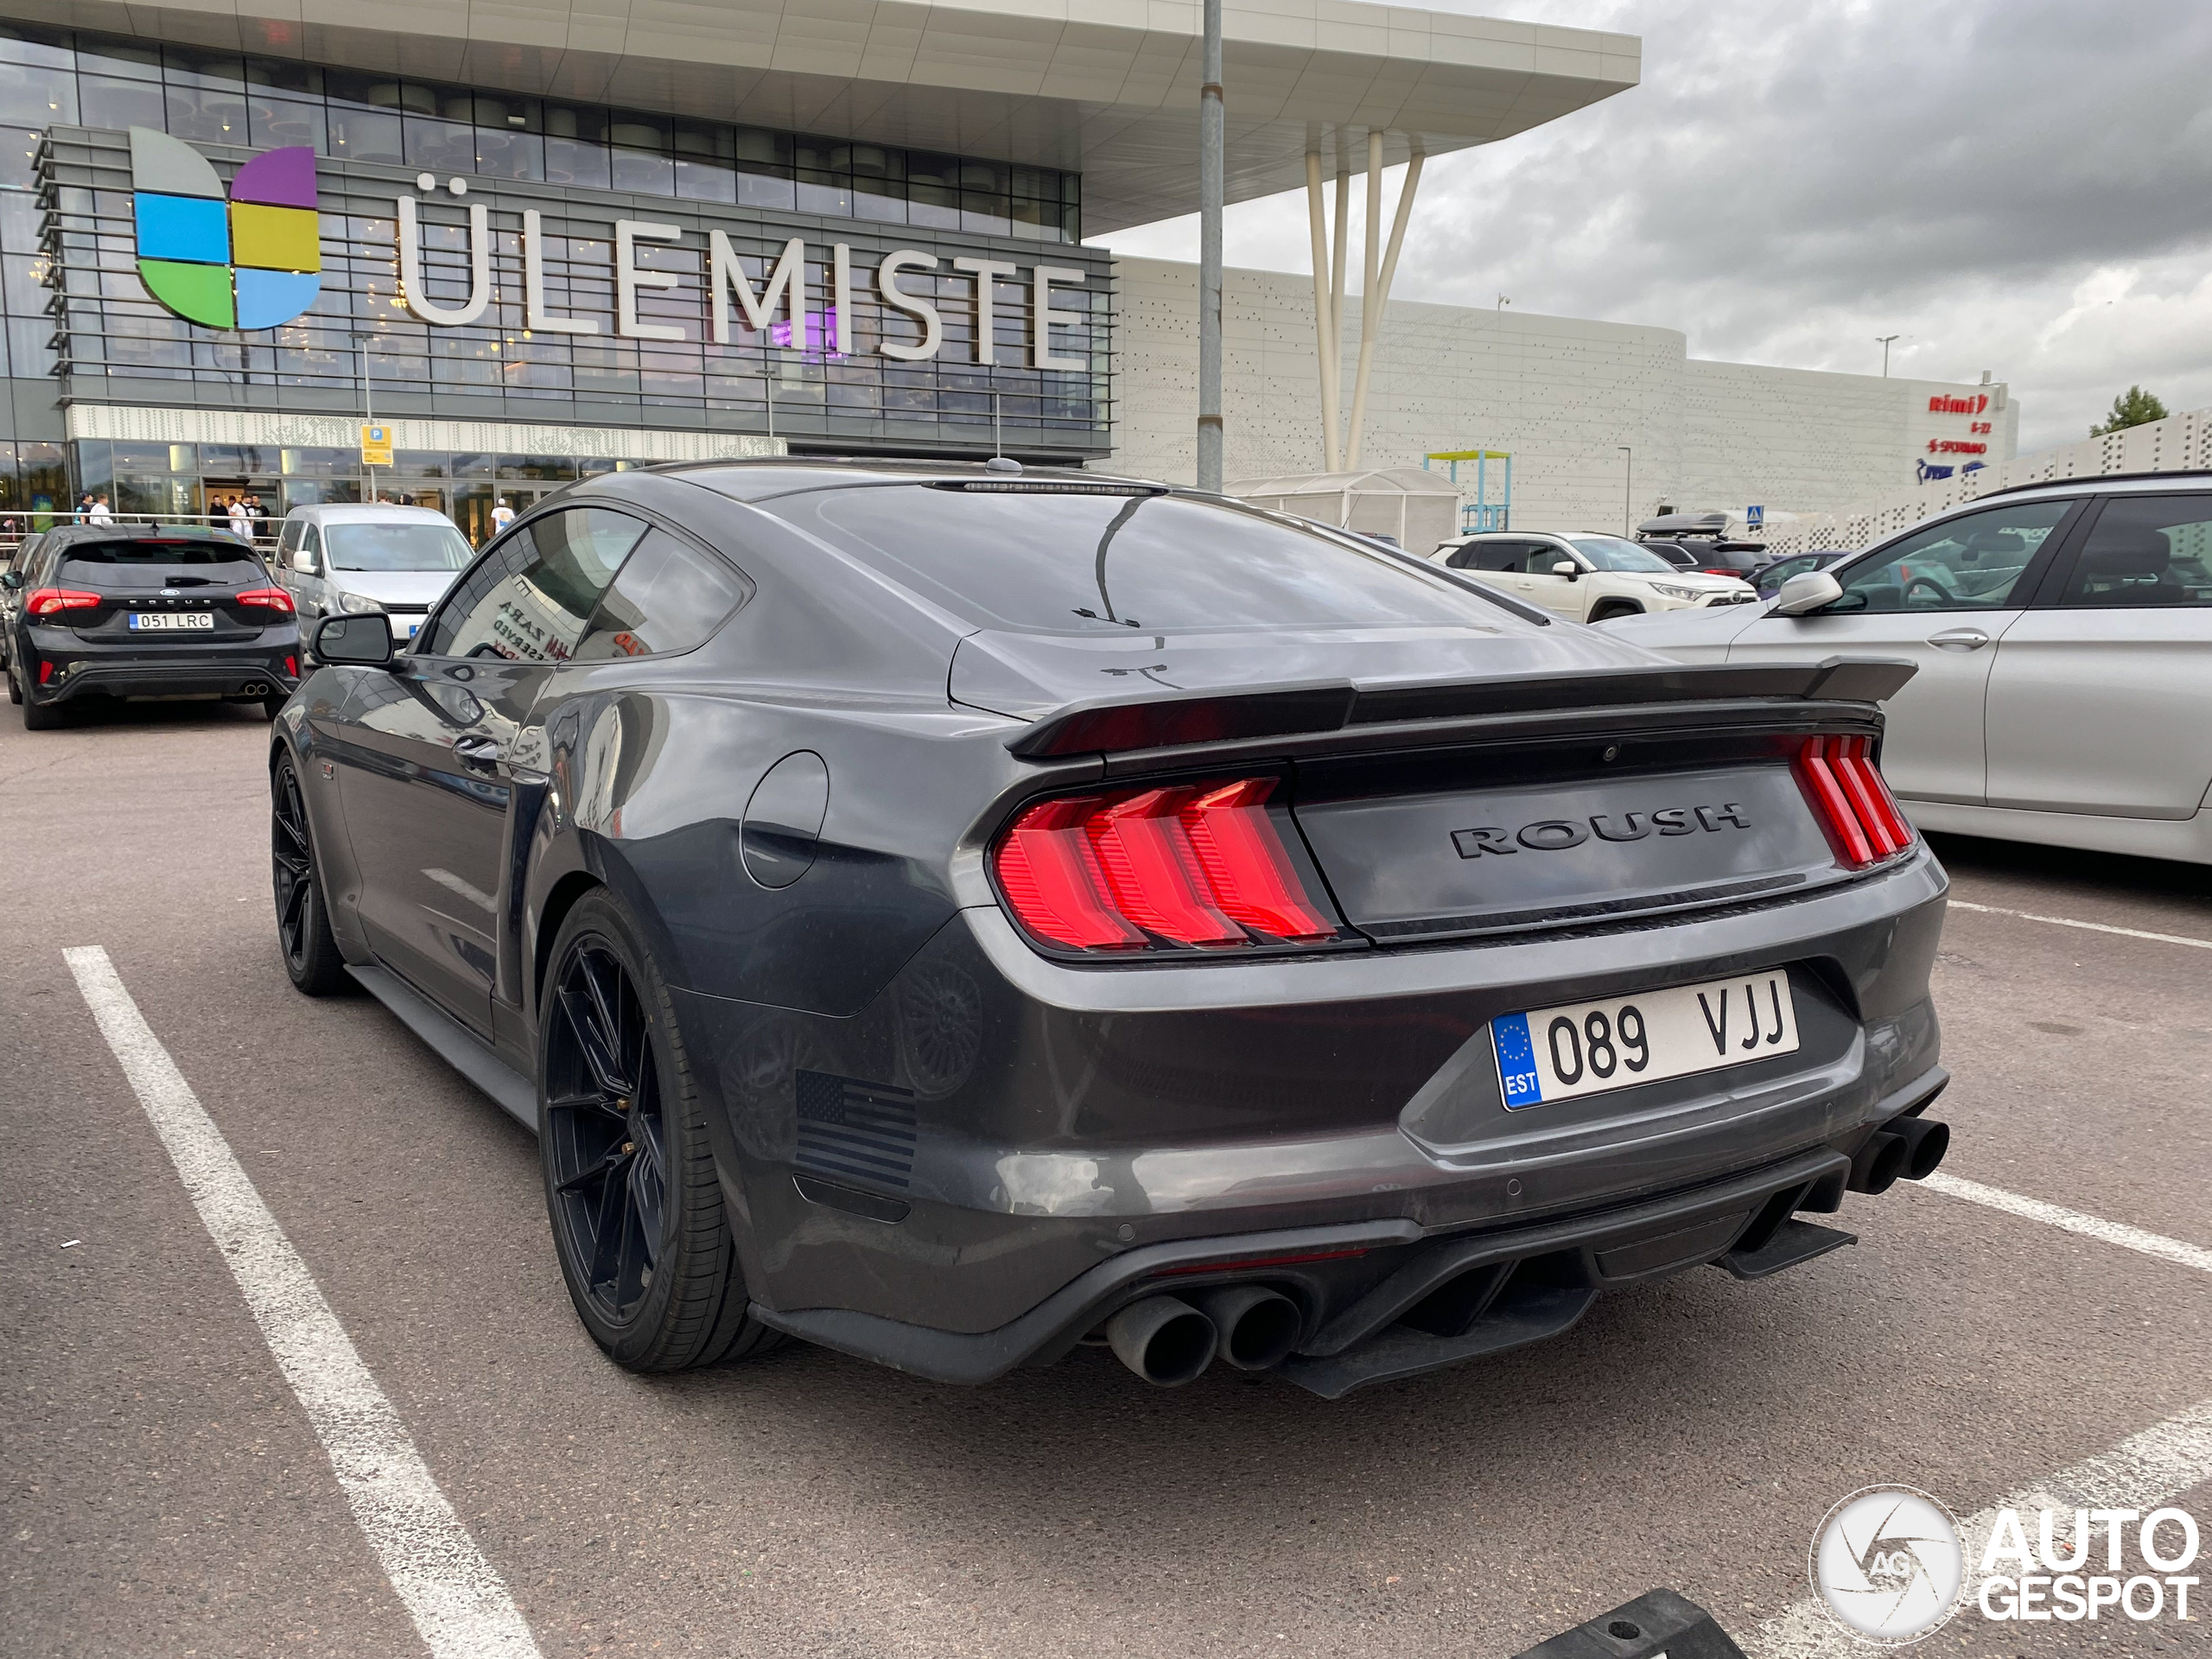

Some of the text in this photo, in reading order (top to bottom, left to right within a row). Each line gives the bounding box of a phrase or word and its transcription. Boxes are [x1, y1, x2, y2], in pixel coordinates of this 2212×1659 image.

[397, 173, 1086, 372] ÜLEMISTE
[142, 615, 209, 627] 051 LRC
[1450, 803, 1751, 859] ROUSH
[1548, 980, 1784, 1085] 089 VJJ
[1505, 1072, 1536, 1096] EST
